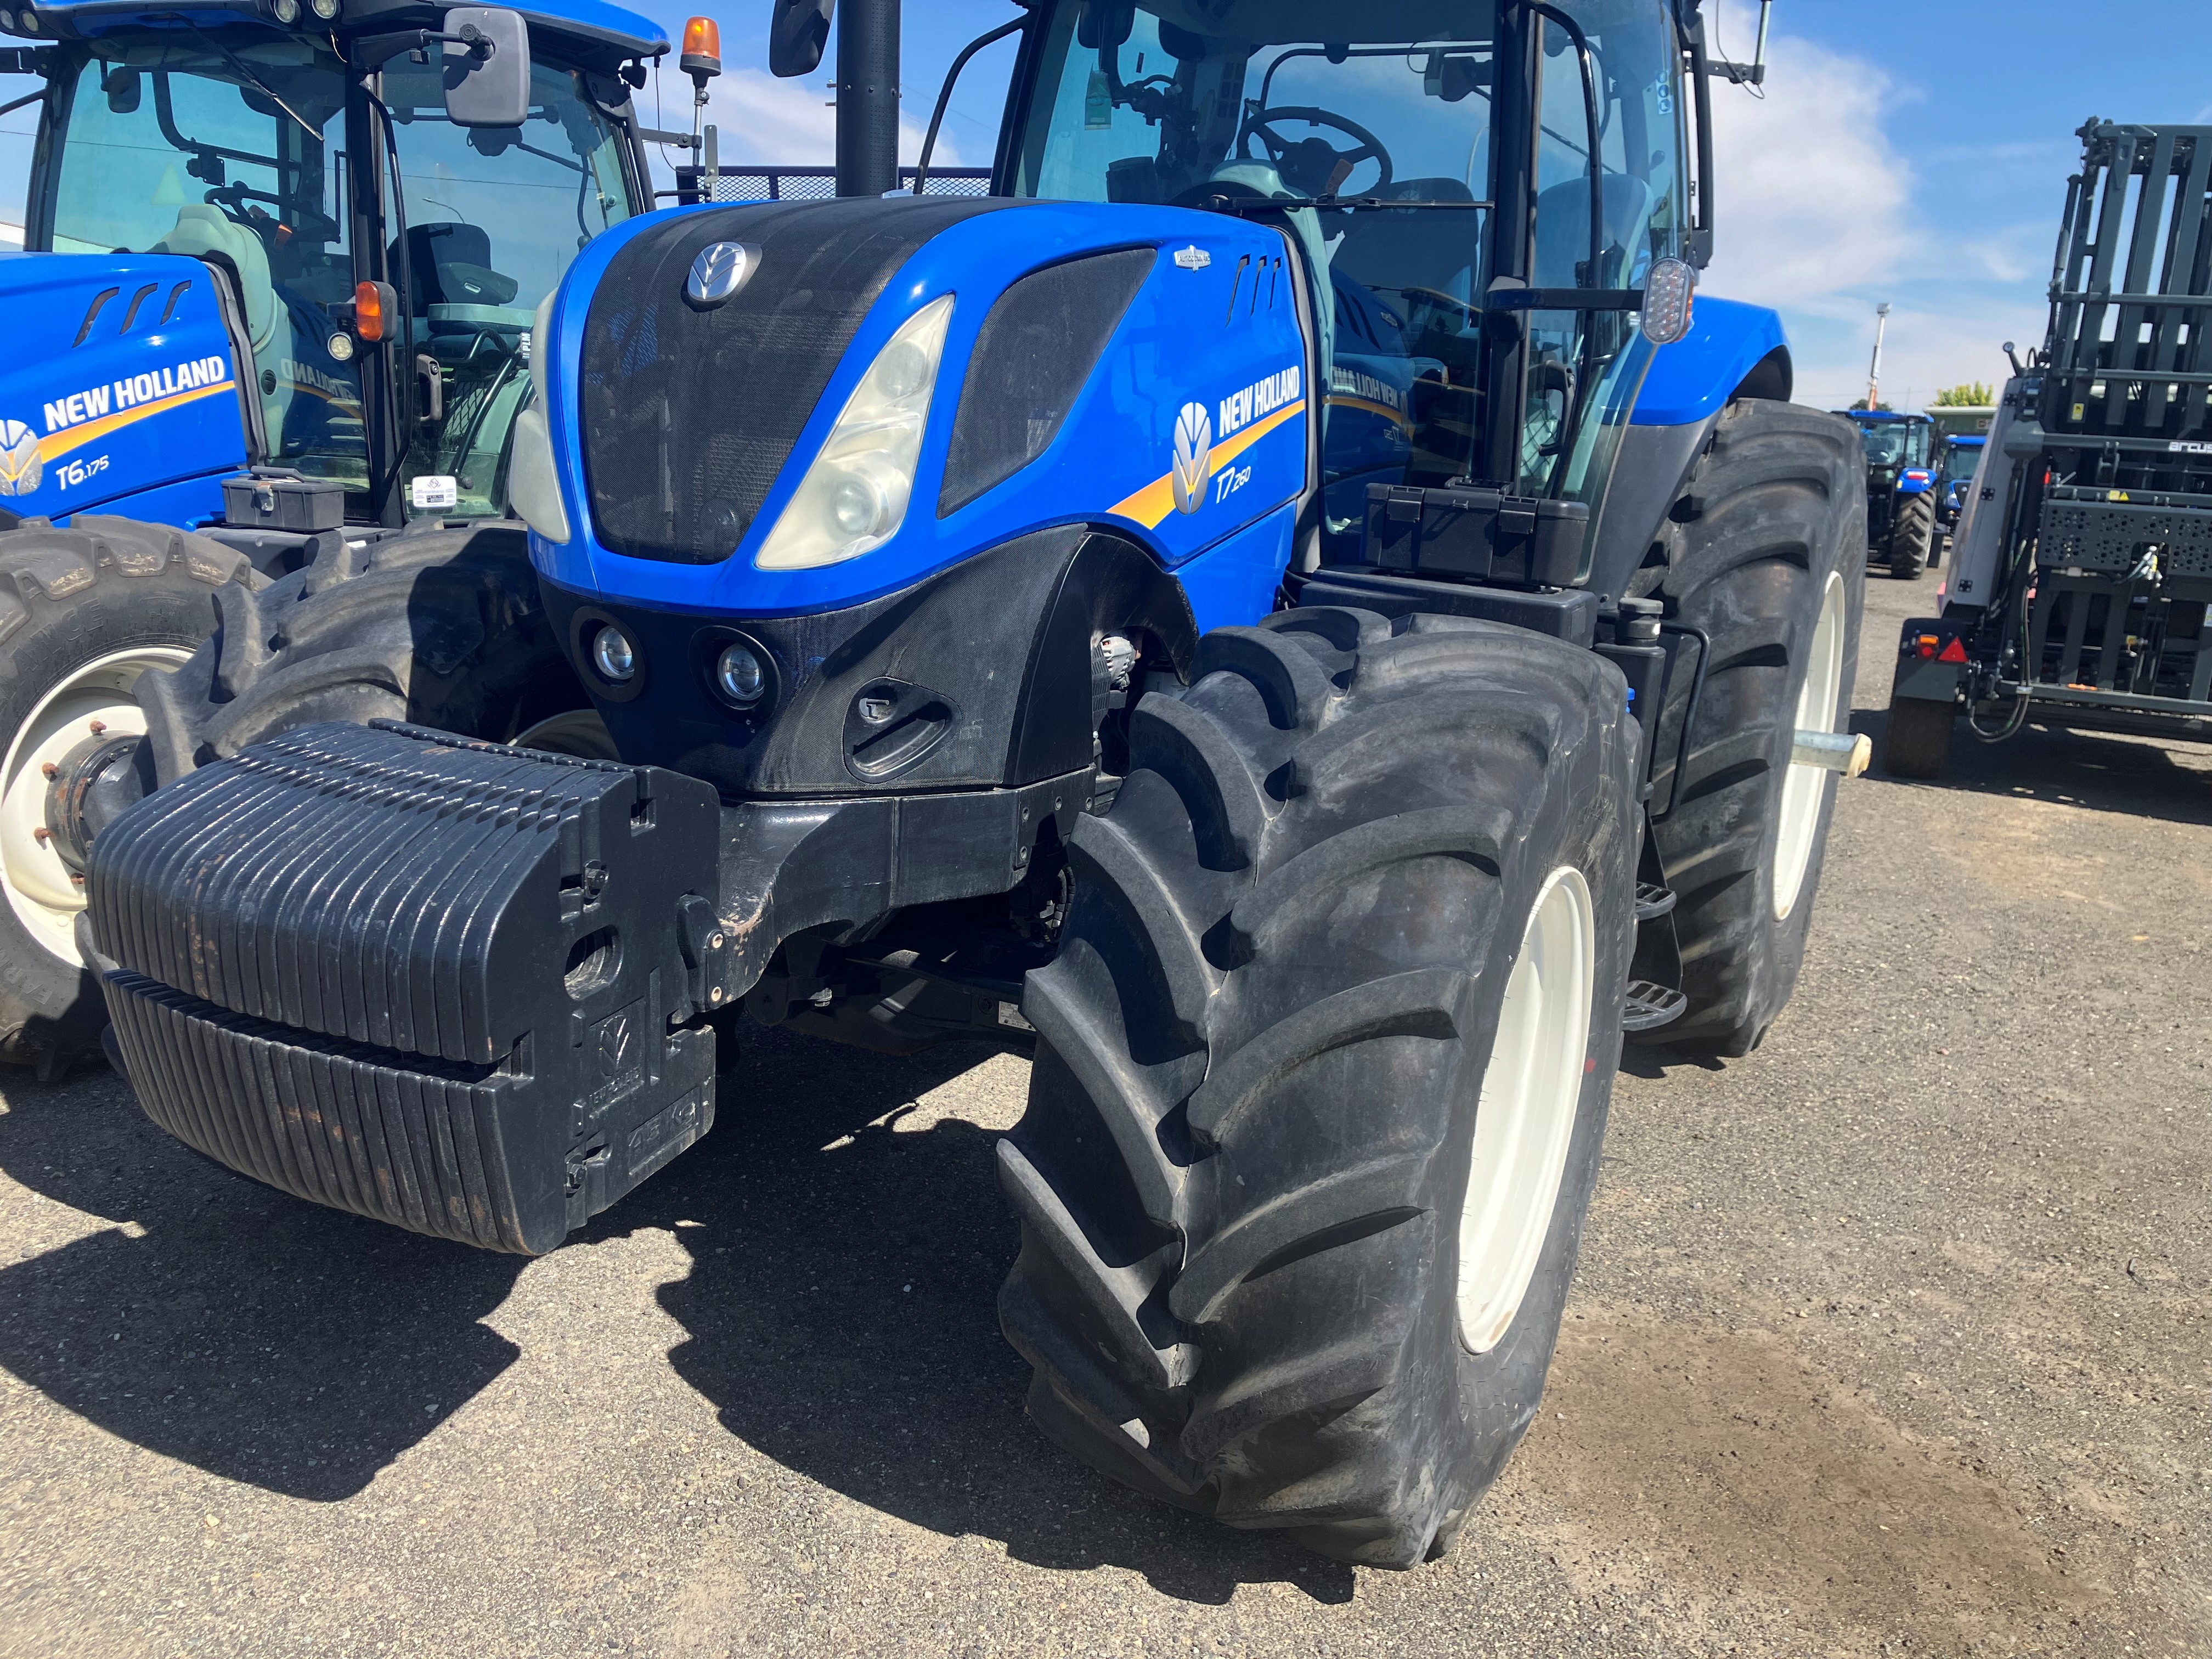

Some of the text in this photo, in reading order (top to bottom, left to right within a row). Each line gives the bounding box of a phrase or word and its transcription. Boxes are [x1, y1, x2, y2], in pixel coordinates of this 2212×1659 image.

[43, 356, 225, 432] NEW HOLLAND
[1219, 365, 1300, 438] NEW HOLLAND
[56, 455, 109, 490] T6.175
[1216, 466, 1251, 504] T7.260
